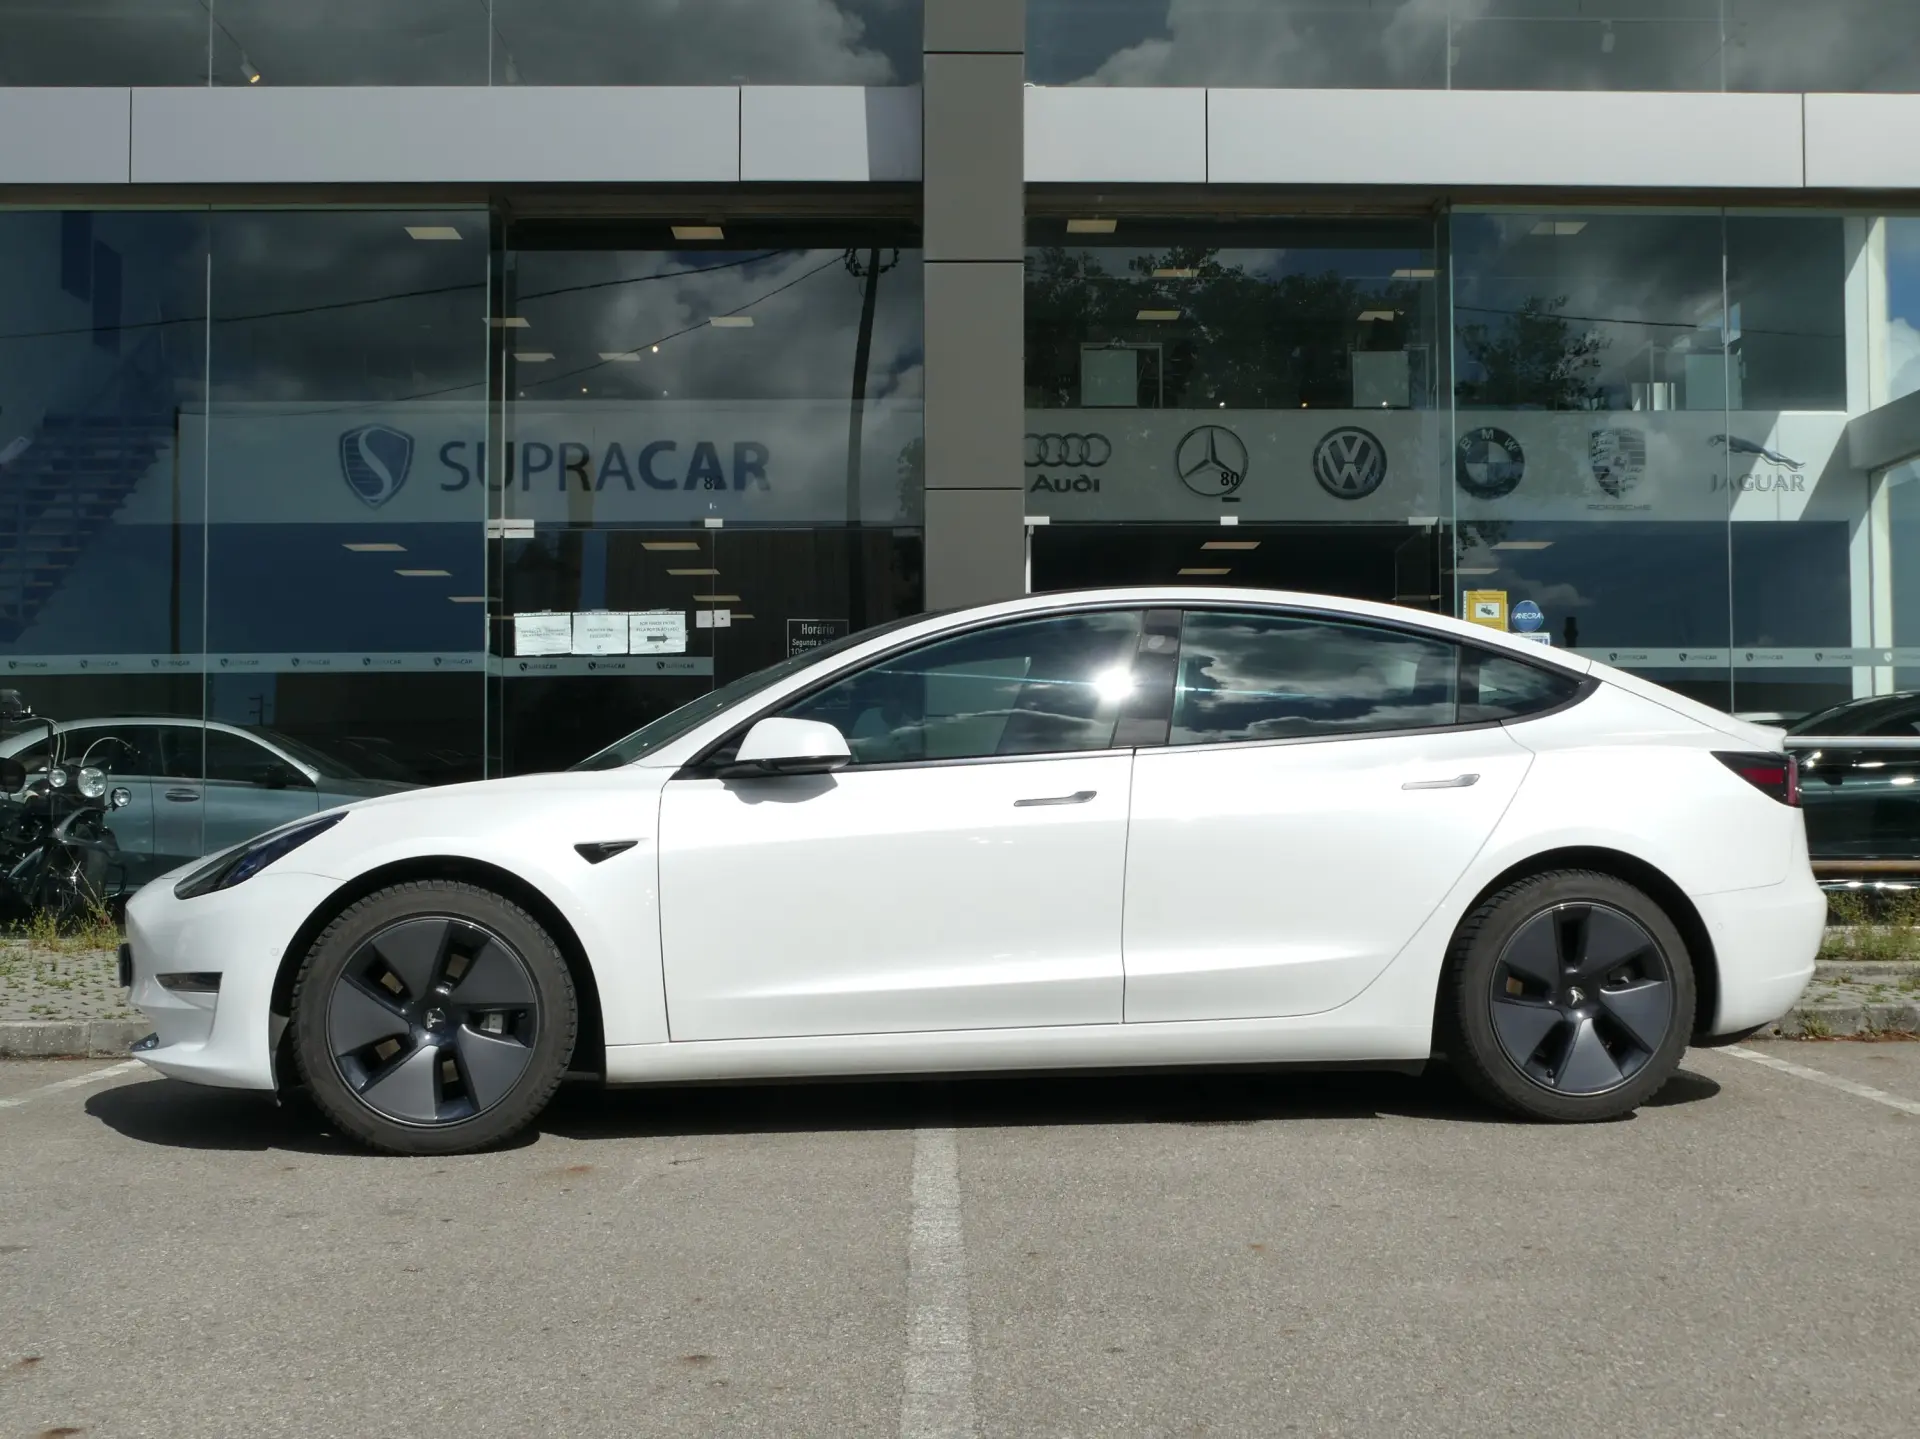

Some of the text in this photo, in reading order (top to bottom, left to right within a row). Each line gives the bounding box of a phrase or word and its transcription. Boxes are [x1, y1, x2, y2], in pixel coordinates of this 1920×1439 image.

[1459, 428, 1521, 452] BMW
[438, 440, 771, 492] SUPRACAR
[1030, 474, 1101, 493] Audi
[1220, 471, 1240, 487] 80
[1709, 473, 1806, 493] JAGUAR
[1515, 612, 1541, 620] ANECRA
[801, 622, 835, 635] Horário
[792, 638, 817, 648] Segunda
